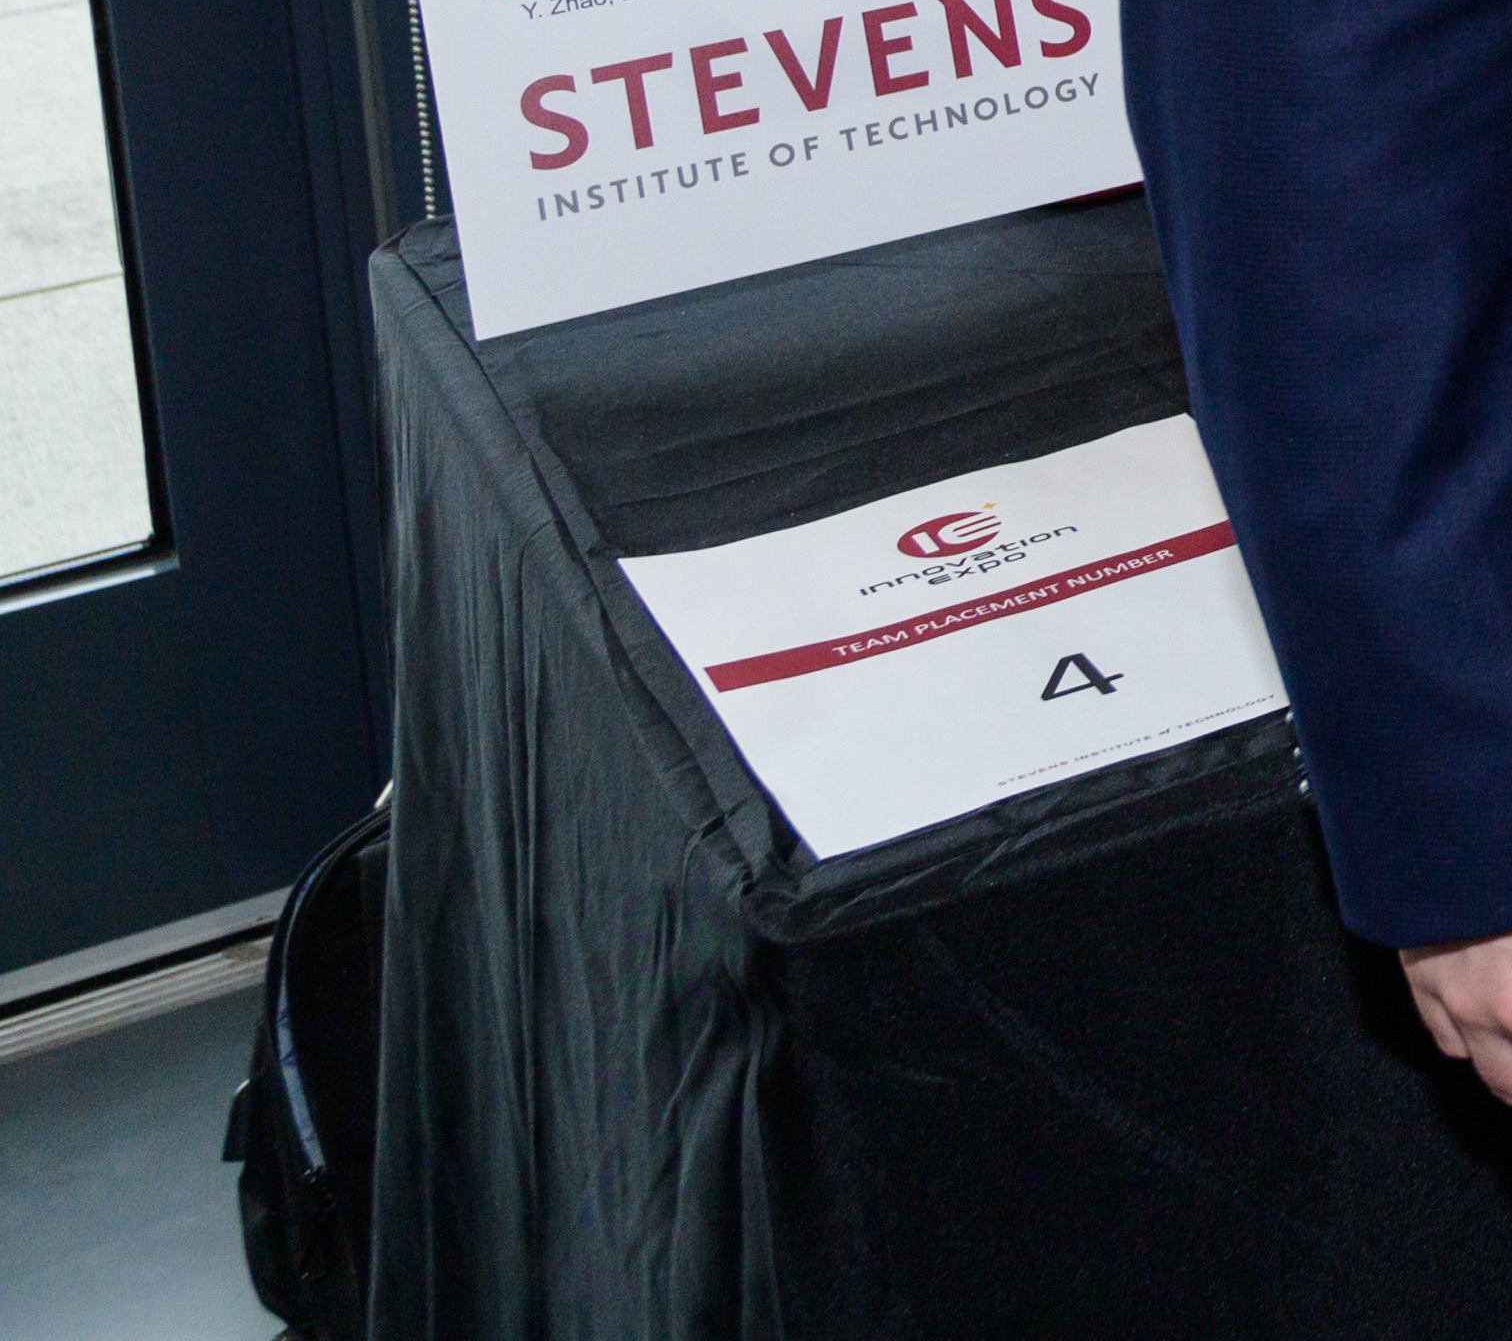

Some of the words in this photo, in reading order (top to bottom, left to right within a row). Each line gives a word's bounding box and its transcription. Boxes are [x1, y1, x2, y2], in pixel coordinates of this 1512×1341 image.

[521, 1, 543, 20] Y.
[537, 152, 750, 221] INSTITUTE
[768, 135, 819, 168] OF
[839, 72, 1099, 152] TECHNOLOGY
[832, 630, 909, 658] TEAM
[913, 582, 1060, 636] PLACEMENT
[1065, 548, 1174, 589] NUMBER
[1040, 652, 1124, 701] 4
